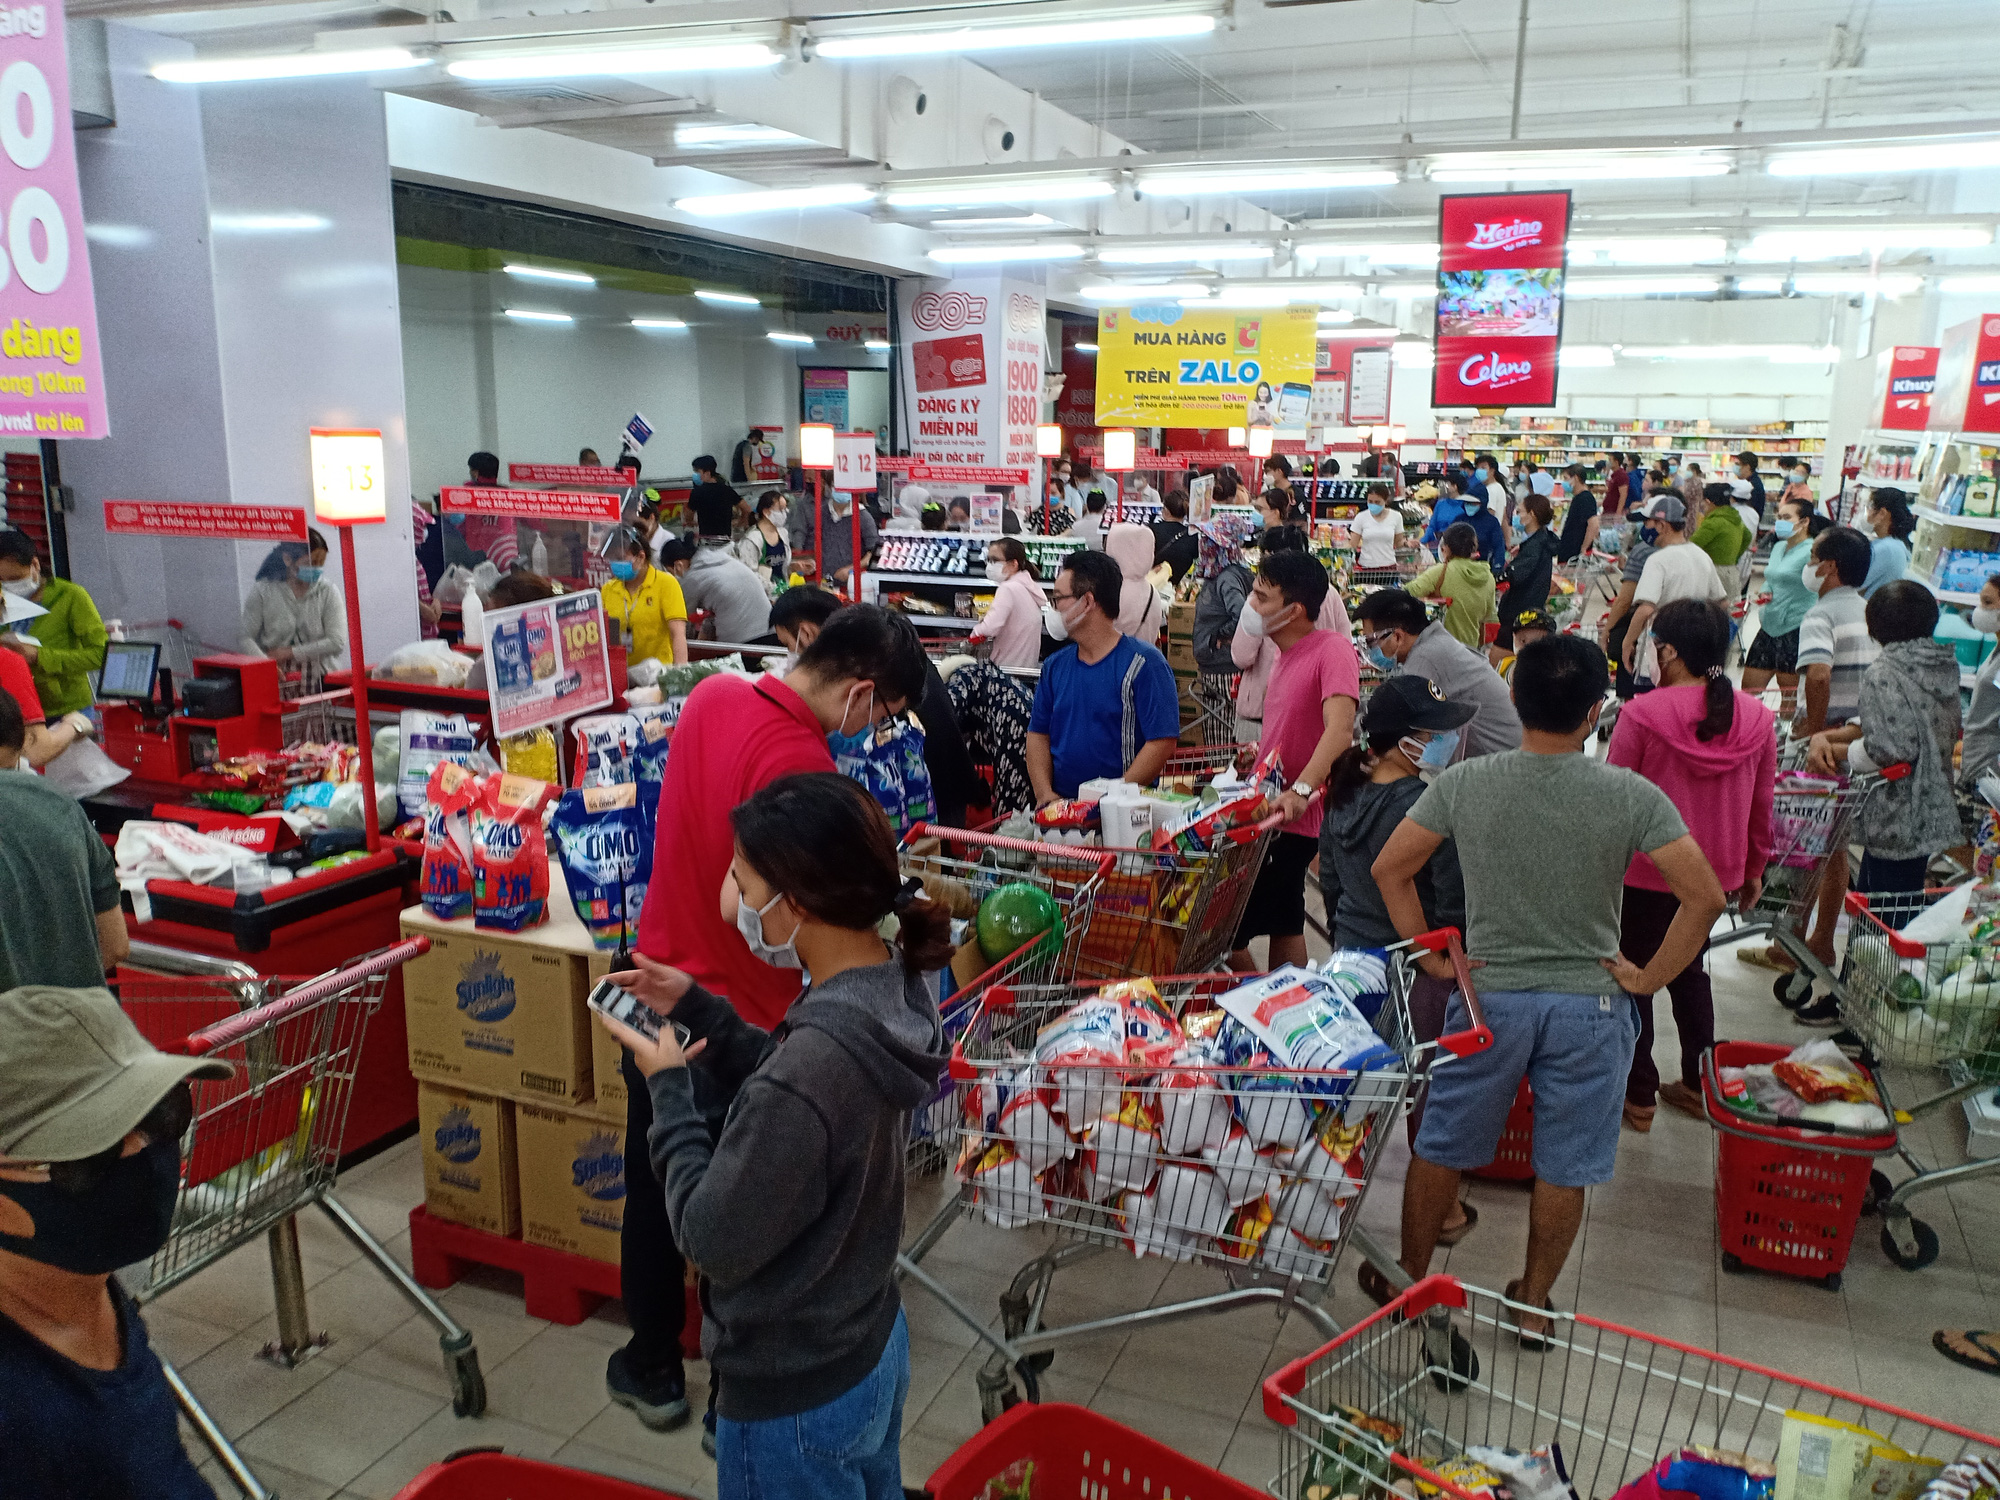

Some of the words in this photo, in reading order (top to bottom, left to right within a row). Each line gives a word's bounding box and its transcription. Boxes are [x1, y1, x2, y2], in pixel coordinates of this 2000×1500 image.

[1472, 218, 1542, 244] Merino
[2, 318, 82, 366] dàng
[1133, 332, 1173, 346] MUA
[1176, 329, 1227, 346] HÀNG
[1007, 360, 1038, 392] 1900
[1124, 367, 1171, 384] TRÊN
[1179, 361, 1260, 384] ZALO
[1459, 351, 1531, 387] Celano
[36, 371, 87, 394] 10km
[917, 394, 956, 414] ĐĂNG
[1221, 393, 1247, 402] 10km
[1007, 394, 1037, 426] 1880
[34, 411, 58, 432] trở
[60, 411, 86, 432] lên
[920, 415, 954, 436] MIỄN
[837, 454, 849, 473] 12
[858, 453, 872, 473] 12
[966, 450, 985, 466] BIỆT
[346, 465, 373, 491] 13
[528, 628, 546, 641] OMO
[562, 621, 599, 651] 108
[503, 641, 522, 657] OMO
[435, 721, 456, 733] OMO
[595, 731, 611, 746] OMO
[484, 821, 523, 848] OMO
[586, 830, 640, 860] OMO
[456, 973, 515, 1010] Sunlight
